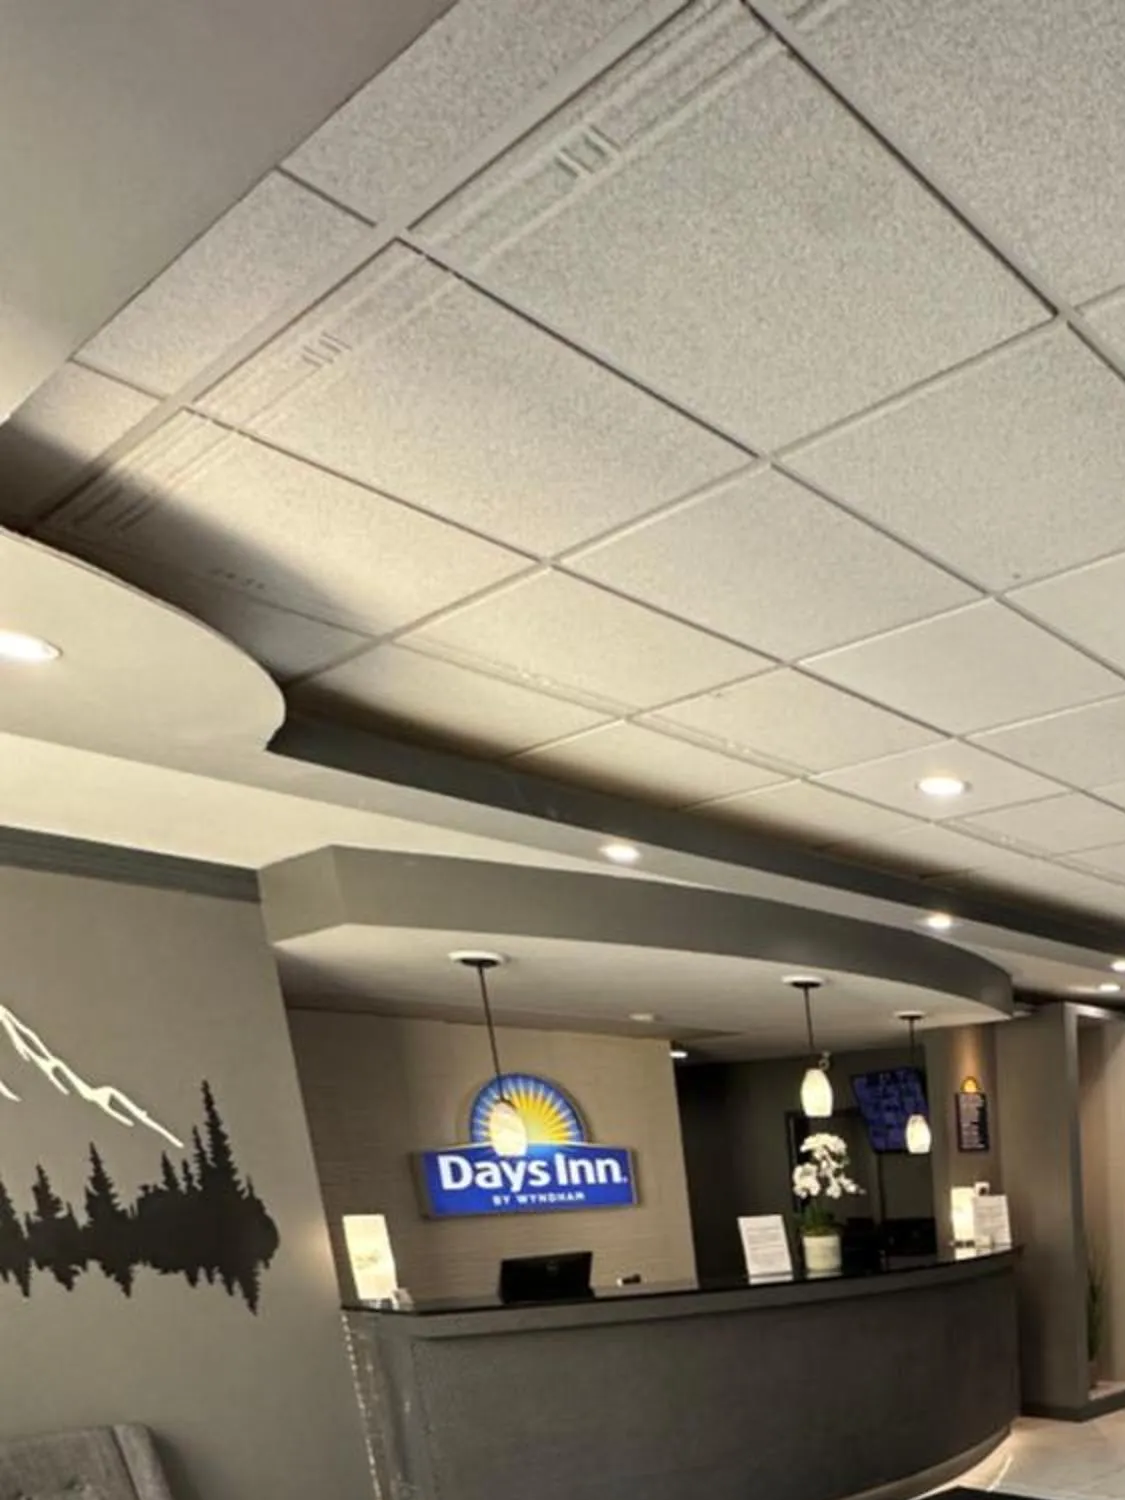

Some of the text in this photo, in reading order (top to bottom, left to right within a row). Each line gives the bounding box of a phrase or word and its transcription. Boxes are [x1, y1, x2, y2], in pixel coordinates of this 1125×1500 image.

[437, 1152, 622, 1192] Days Inn
[493, 1191, 586, 1206] BY WYNDHAM
